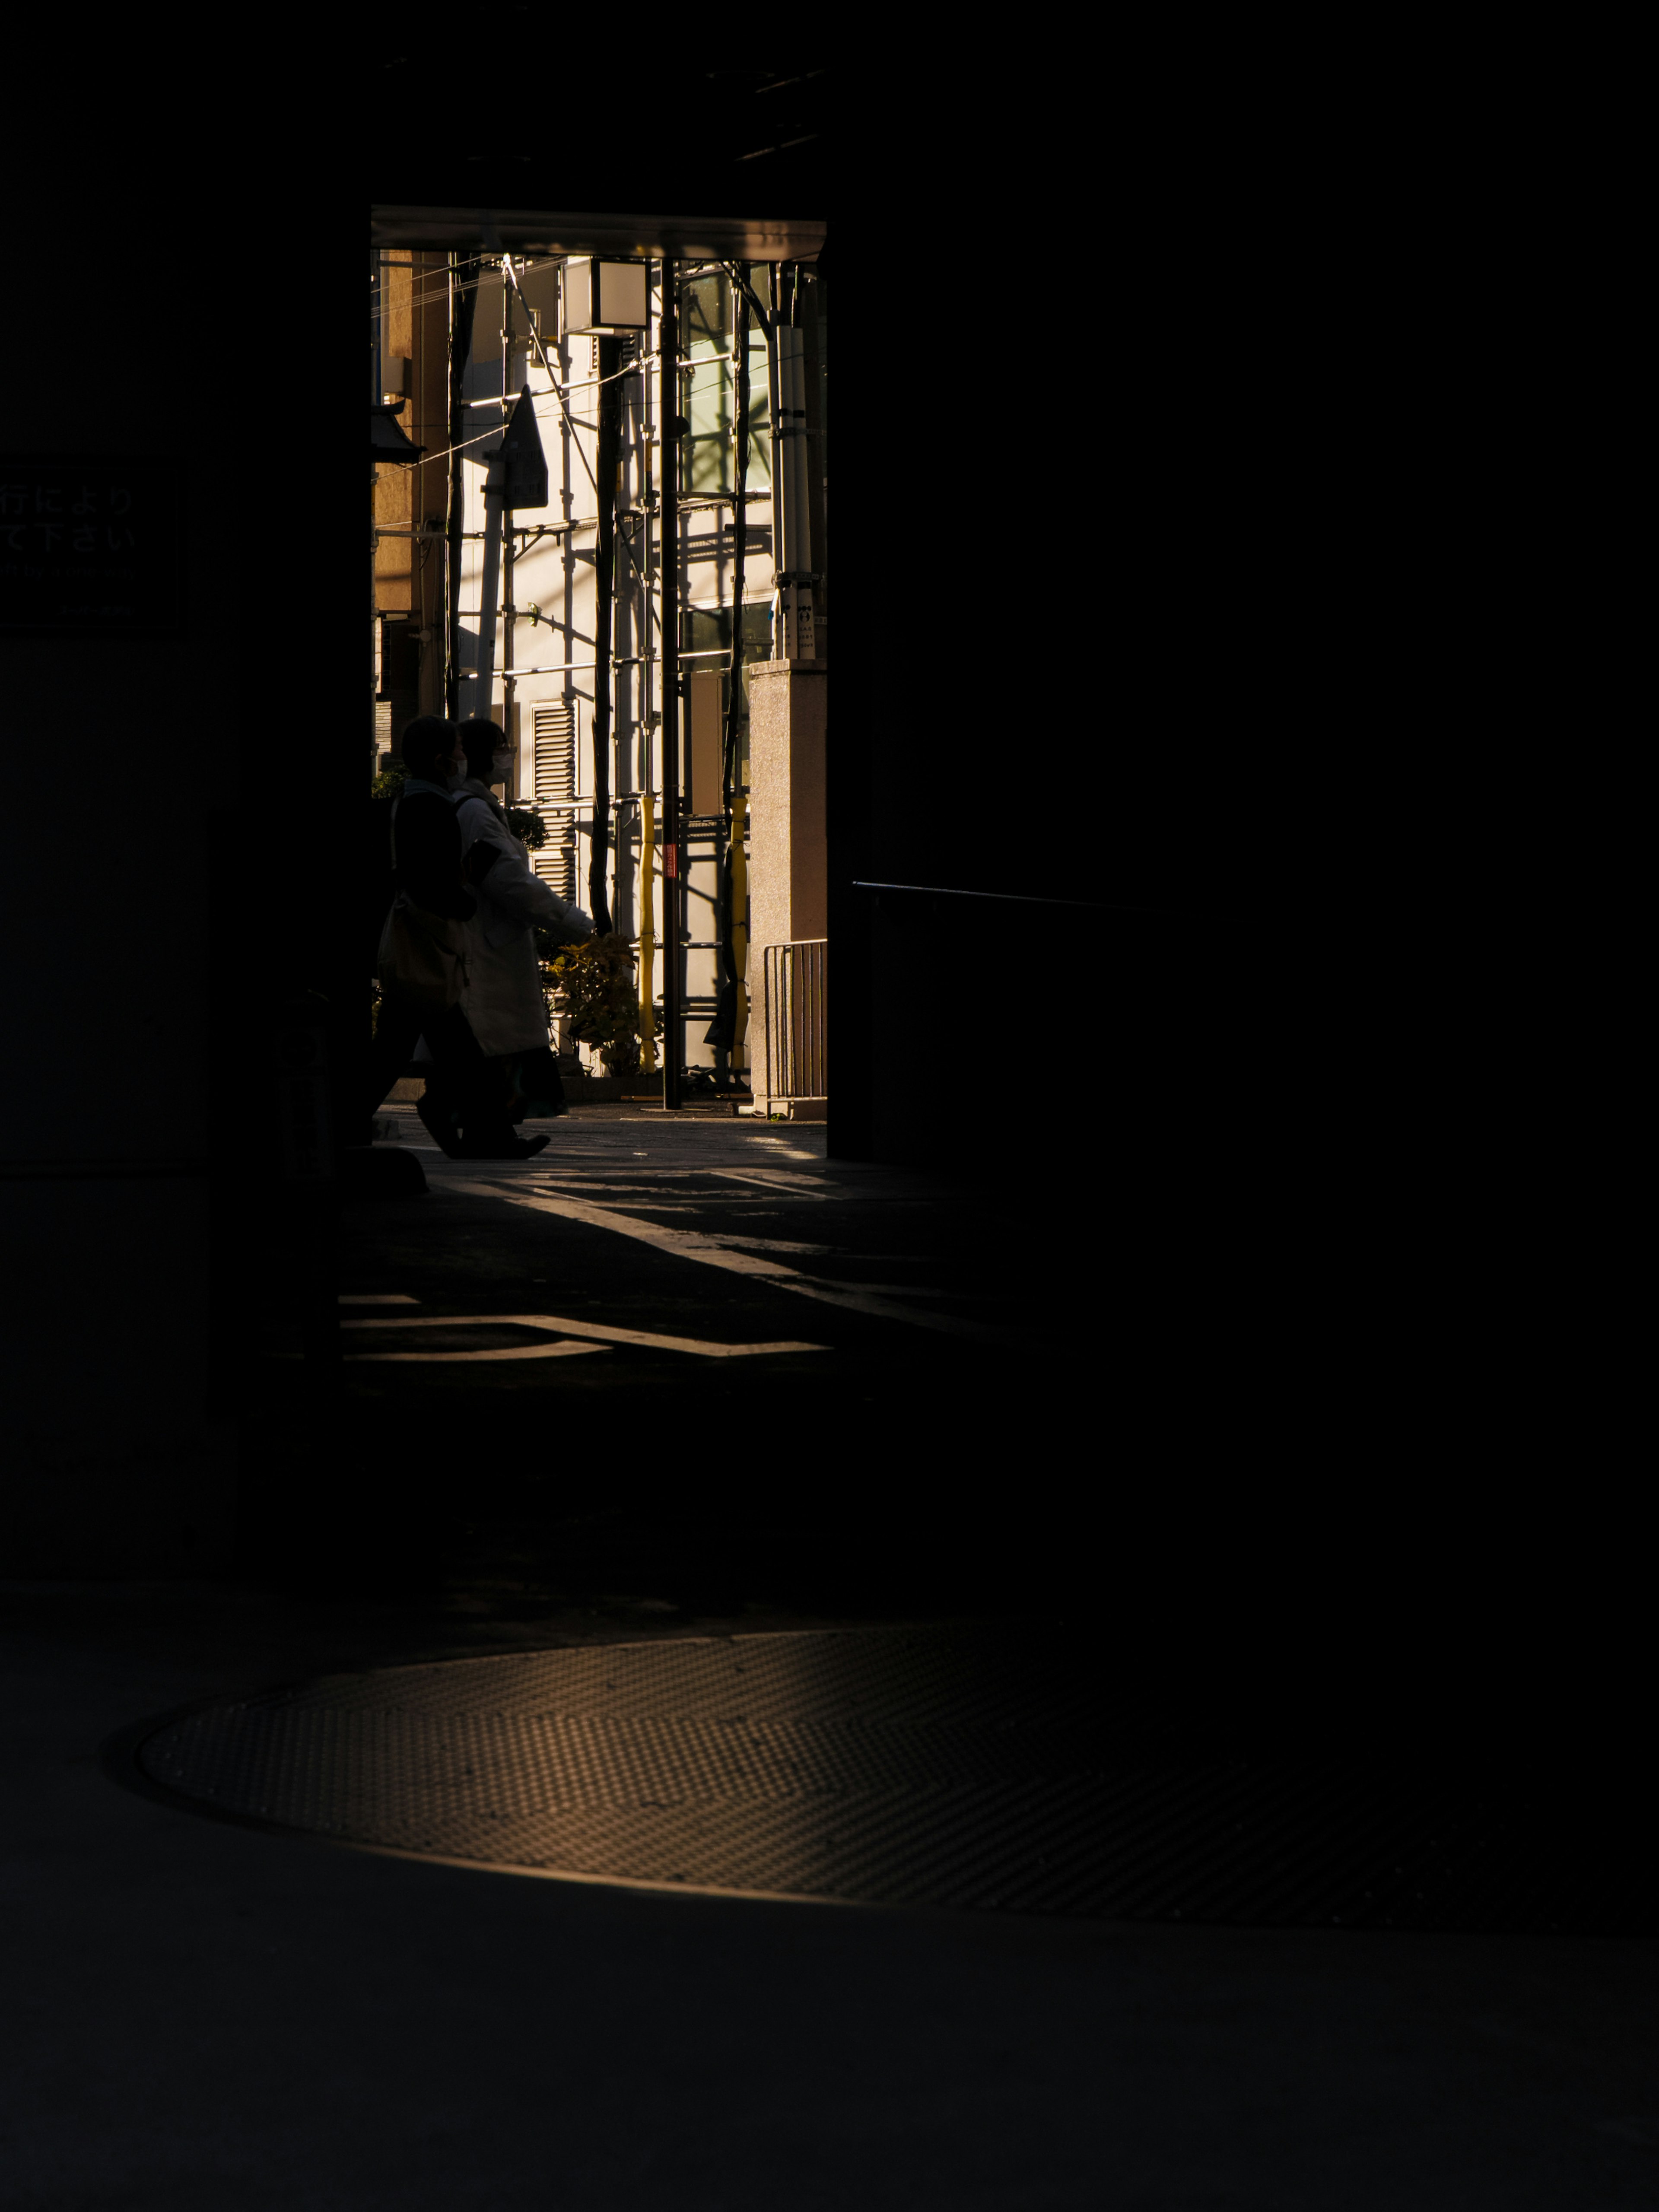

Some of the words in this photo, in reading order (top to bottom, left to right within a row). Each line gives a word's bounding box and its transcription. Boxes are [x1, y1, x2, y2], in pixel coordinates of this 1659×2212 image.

[0, 483, 133, 515] 行により
[0, 523, 135, 553] て下さい
[24, 563, 44, 580] by
[51, 567, 60, 577] a
[66, 566, 136, 580] one-way
